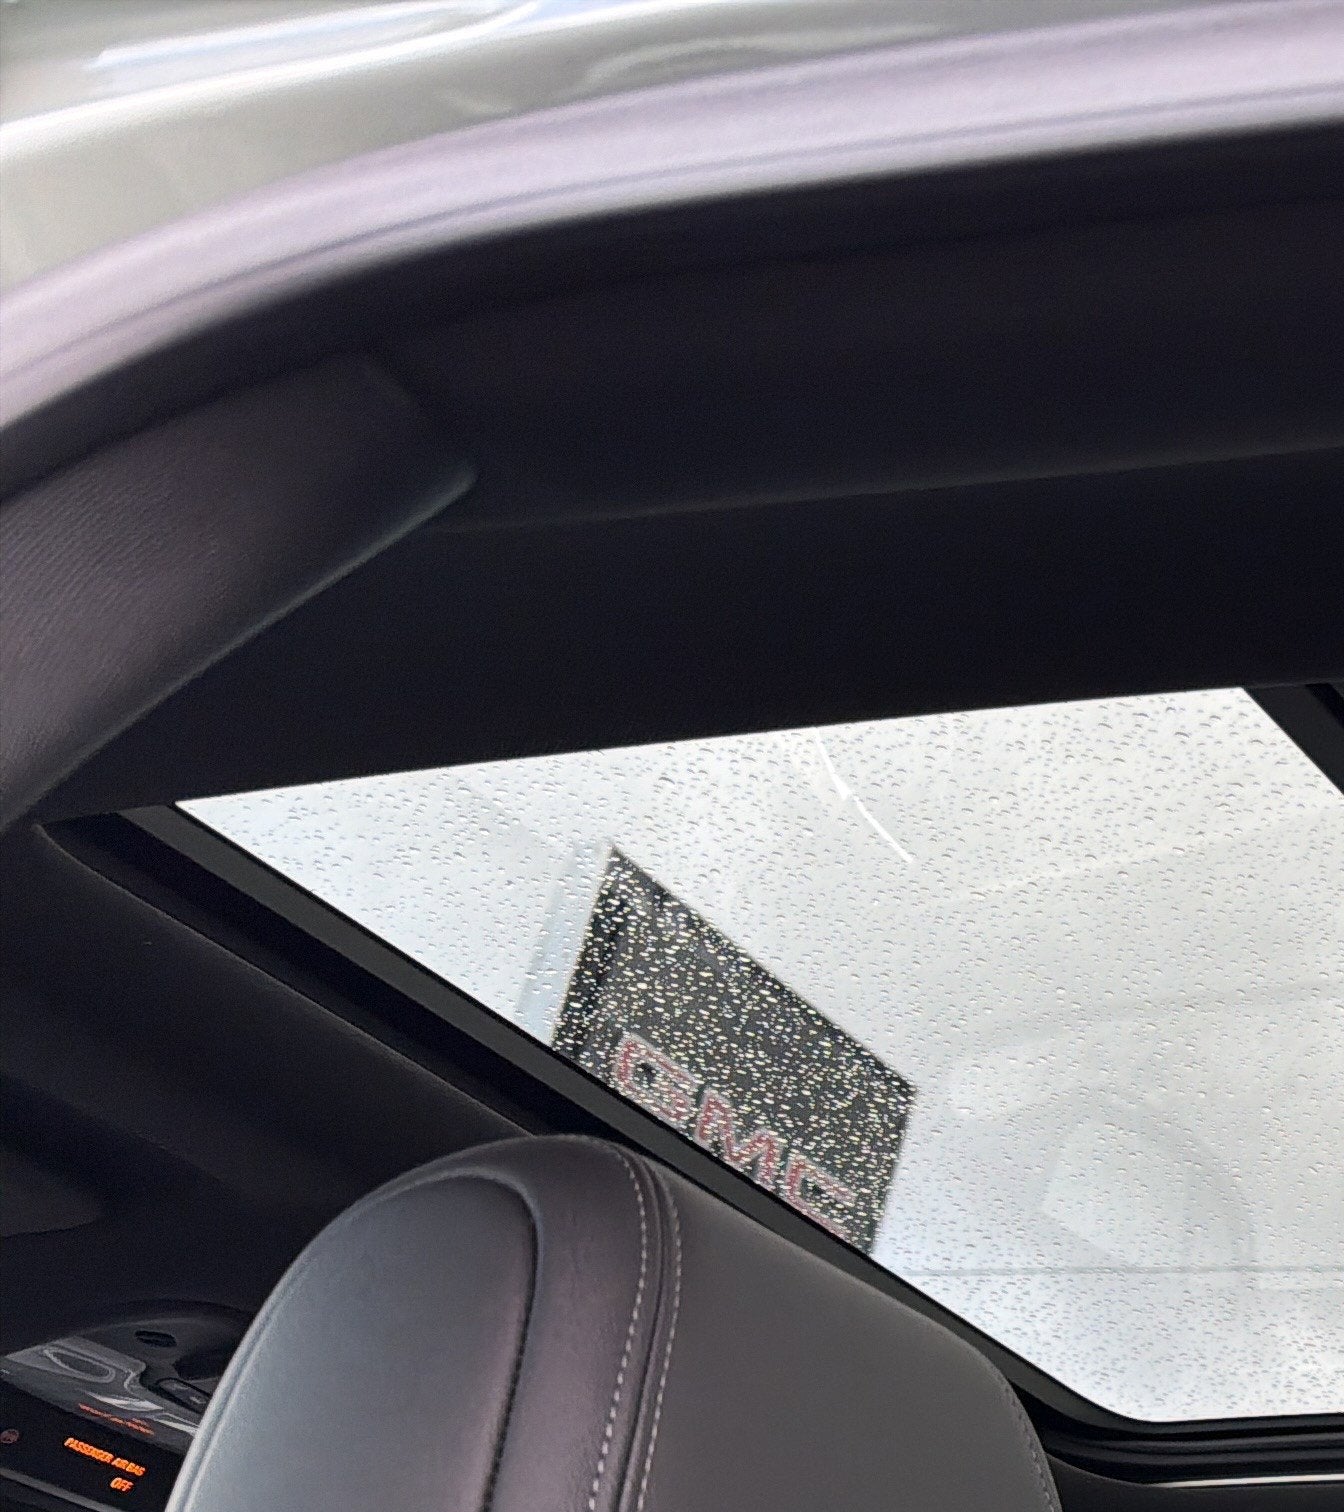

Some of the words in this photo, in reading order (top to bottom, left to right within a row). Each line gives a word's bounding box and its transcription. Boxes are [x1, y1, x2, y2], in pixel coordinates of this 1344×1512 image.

[613, 1034, 856, 1241] GMC
[64, 1438, 114, 1463] PASSENGER
[110, 1477, 134, 1491] OFF
